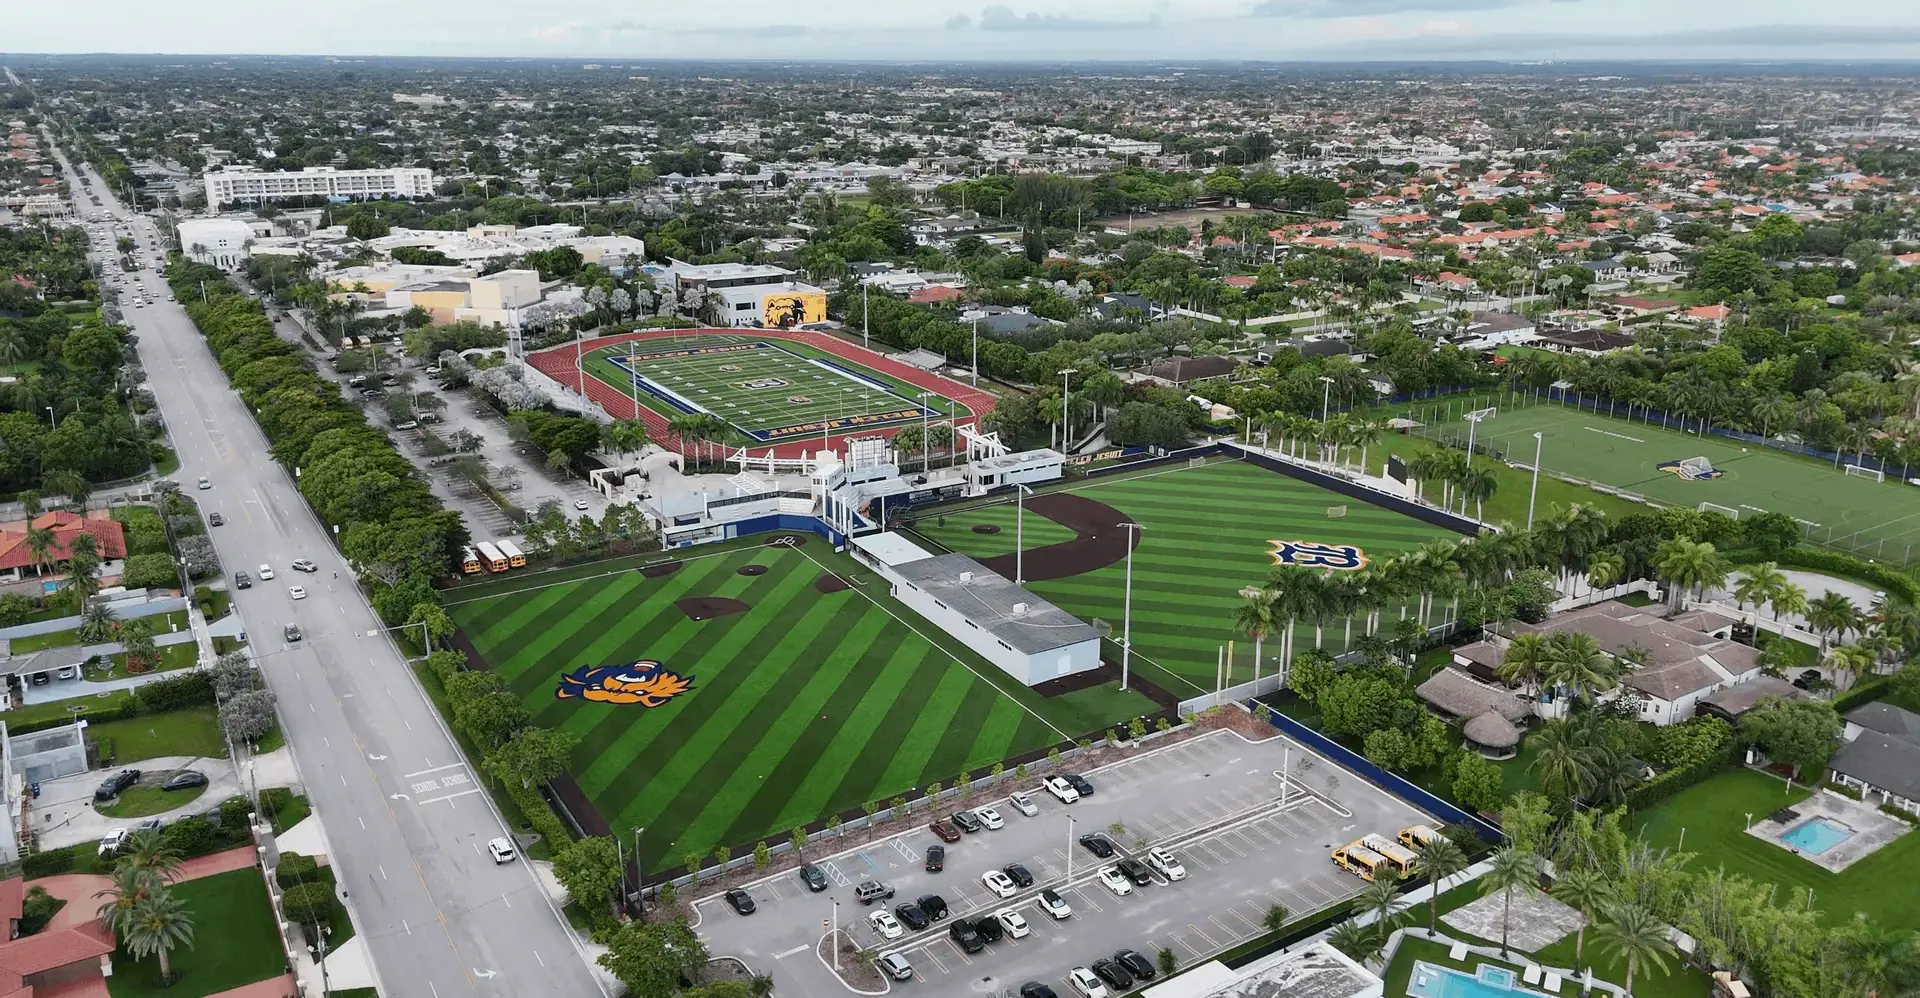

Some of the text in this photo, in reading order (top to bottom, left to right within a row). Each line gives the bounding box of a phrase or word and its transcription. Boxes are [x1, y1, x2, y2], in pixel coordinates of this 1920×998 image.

[1093, 449, 1124, 461] JESUIT
[411, 773, 470, 794] SCHOOL SCHOOL
